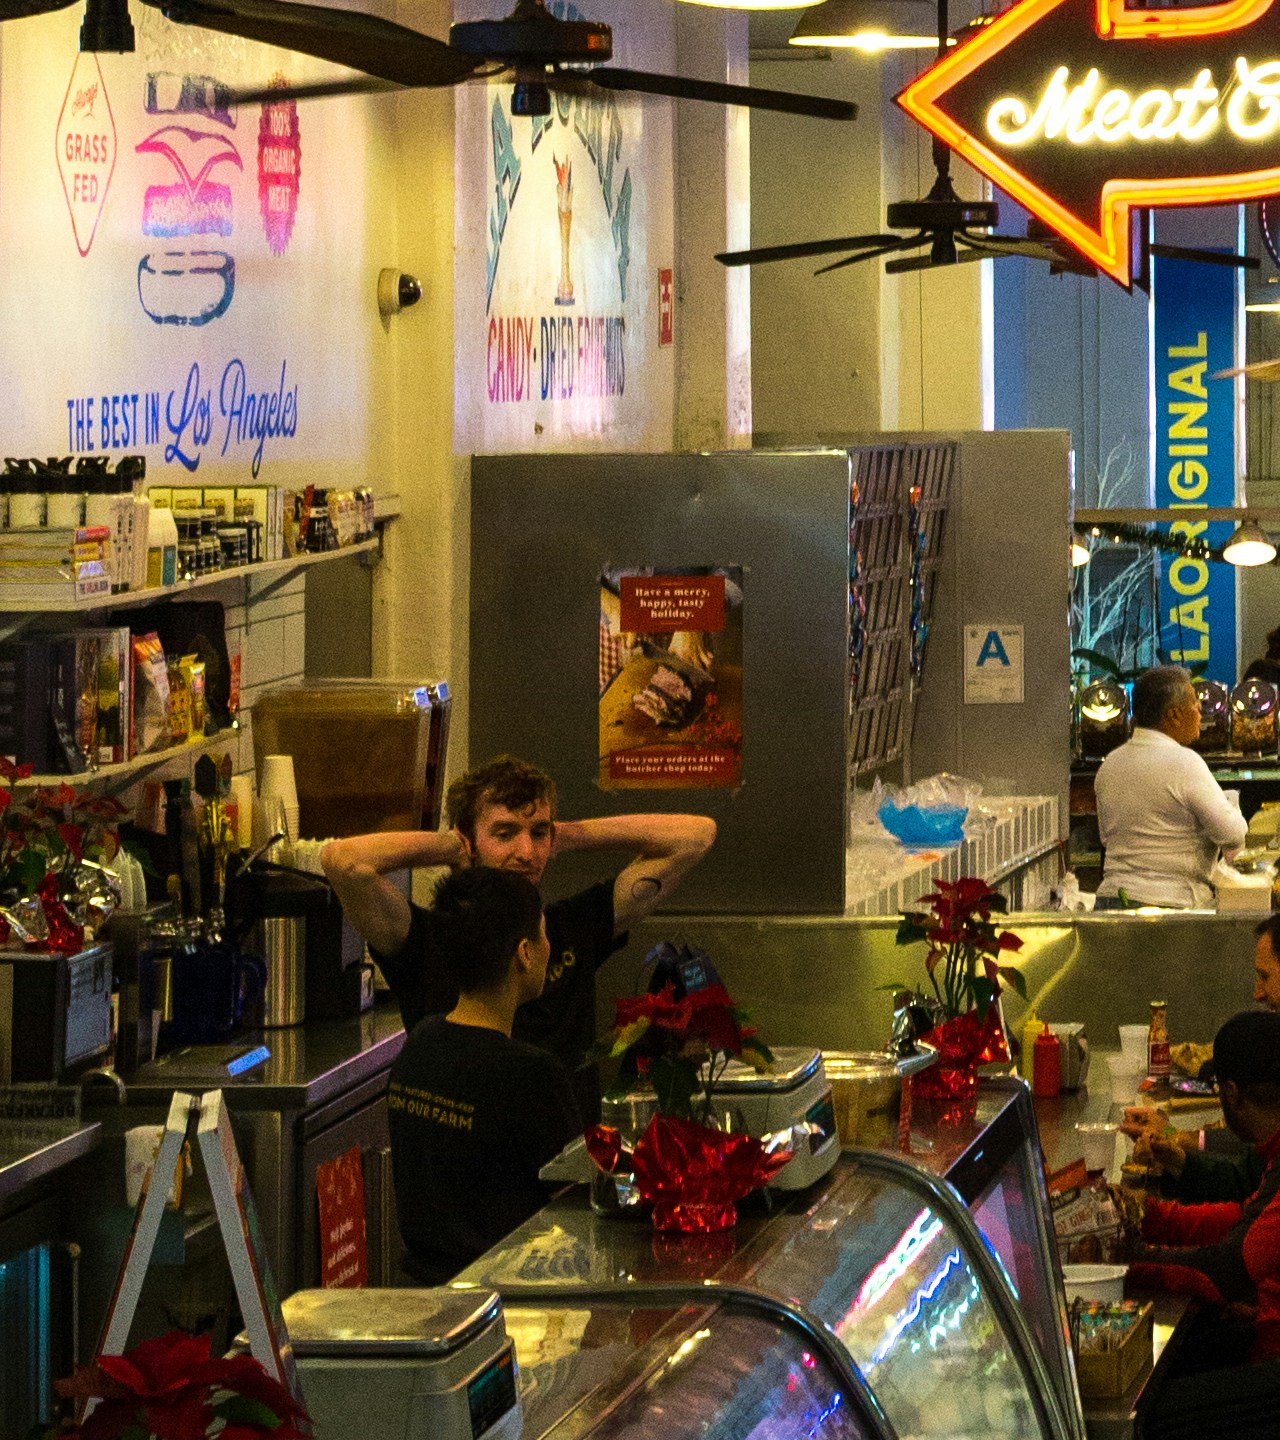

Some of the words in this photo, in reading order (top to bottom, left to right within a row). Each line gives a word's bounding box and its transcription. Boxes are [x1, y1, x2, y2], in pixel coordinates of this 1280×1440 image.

[987, 66, 1216, 146] Meat
[65, 133, 108, 163] GRASS
[263, 146, 297, 175] ORGANIC
[73, 174, 99, 203] FED
[268, 185, 291, 212] MEAT
[486, 316, 534, 403] CANDY
[540, 316, 574, 401] DRIED
[67, 397, 95, 453] THE
[101, 393, 139, 450] BEST
[145, 391, 160, 446] IN
[164, 361, 212, 472] Los
[219, 357, 298, 480] Angeles
[635, 587, 662, 597] Have
[664, 588, 671, 597] a
[673, 588, 711, 599] merry,
[640, 597, 676, 609] happy,
[678, 597, 705, 608] tasty
[650, 607, 695, 620] holiday.
[976, 631, 1011, 667] A
